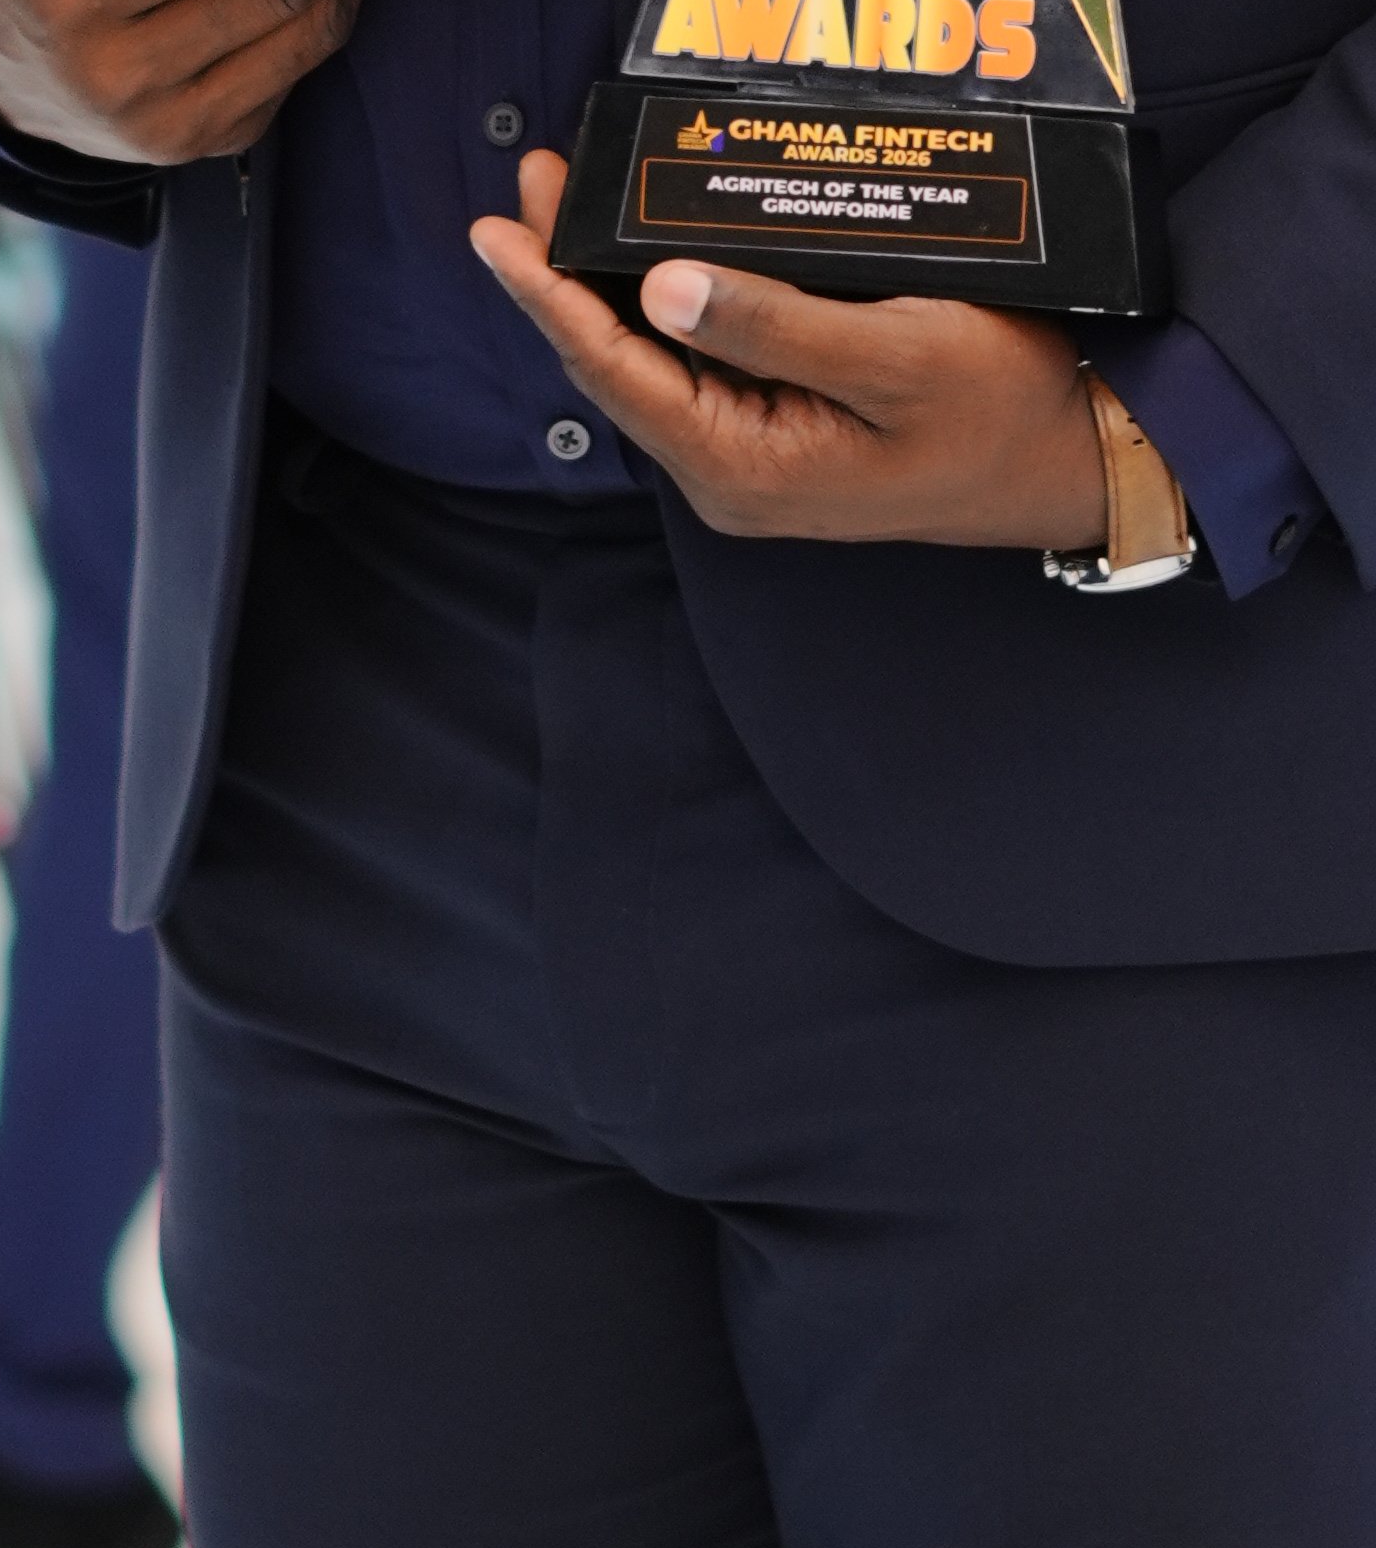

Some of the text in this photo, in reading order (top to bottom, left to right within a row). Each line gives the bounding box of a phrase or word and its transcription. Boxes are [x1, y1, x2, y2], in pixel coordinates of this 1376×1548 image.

[728, 118, 847, 145] GHANA
[855, 125, 994, 152] FINTECH
[782, 144, 932, 167] AWARDS 2026
[706, 175, 969, 204] AGRITECH OF THE YEAR
[761, 197, 912, 220] GROWFORME
